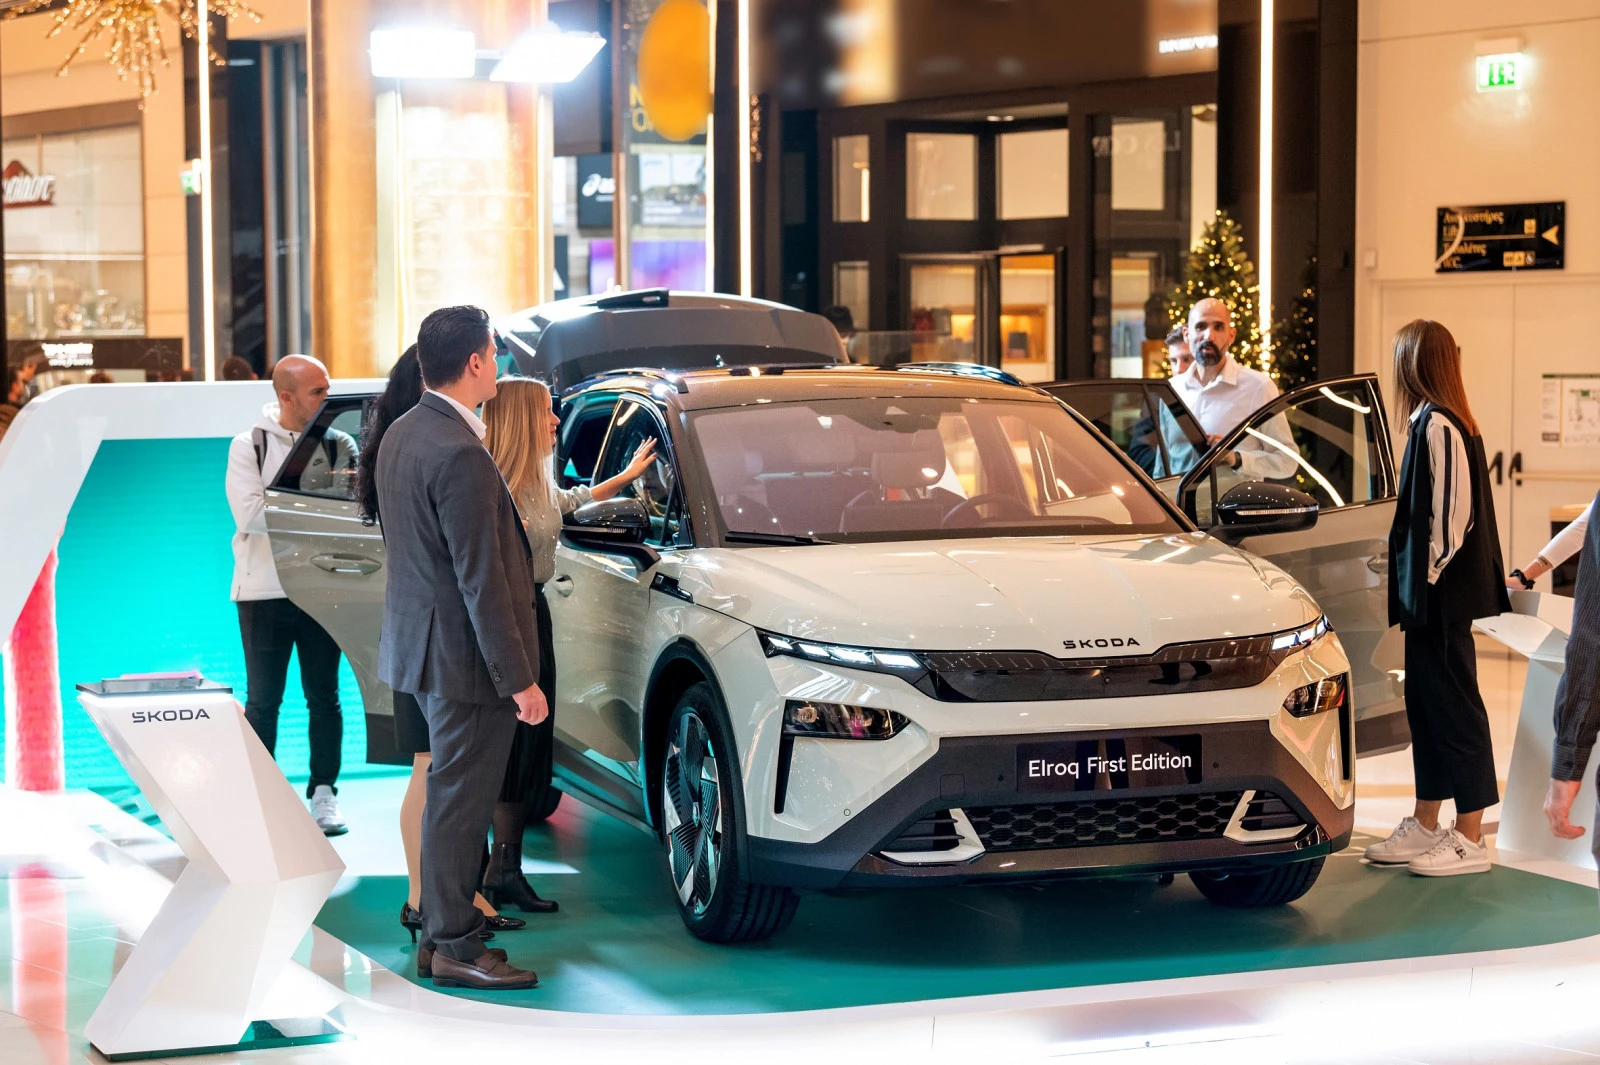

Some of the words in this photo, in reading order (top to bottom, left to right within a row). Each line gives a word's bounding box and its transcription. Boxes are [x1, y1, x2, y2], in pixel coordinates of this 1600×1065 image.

[1028, 759, 1080, 779] Elroq
[1087, 756, 1127, 774] First
[1131, 752, 1192, 771] Edition
